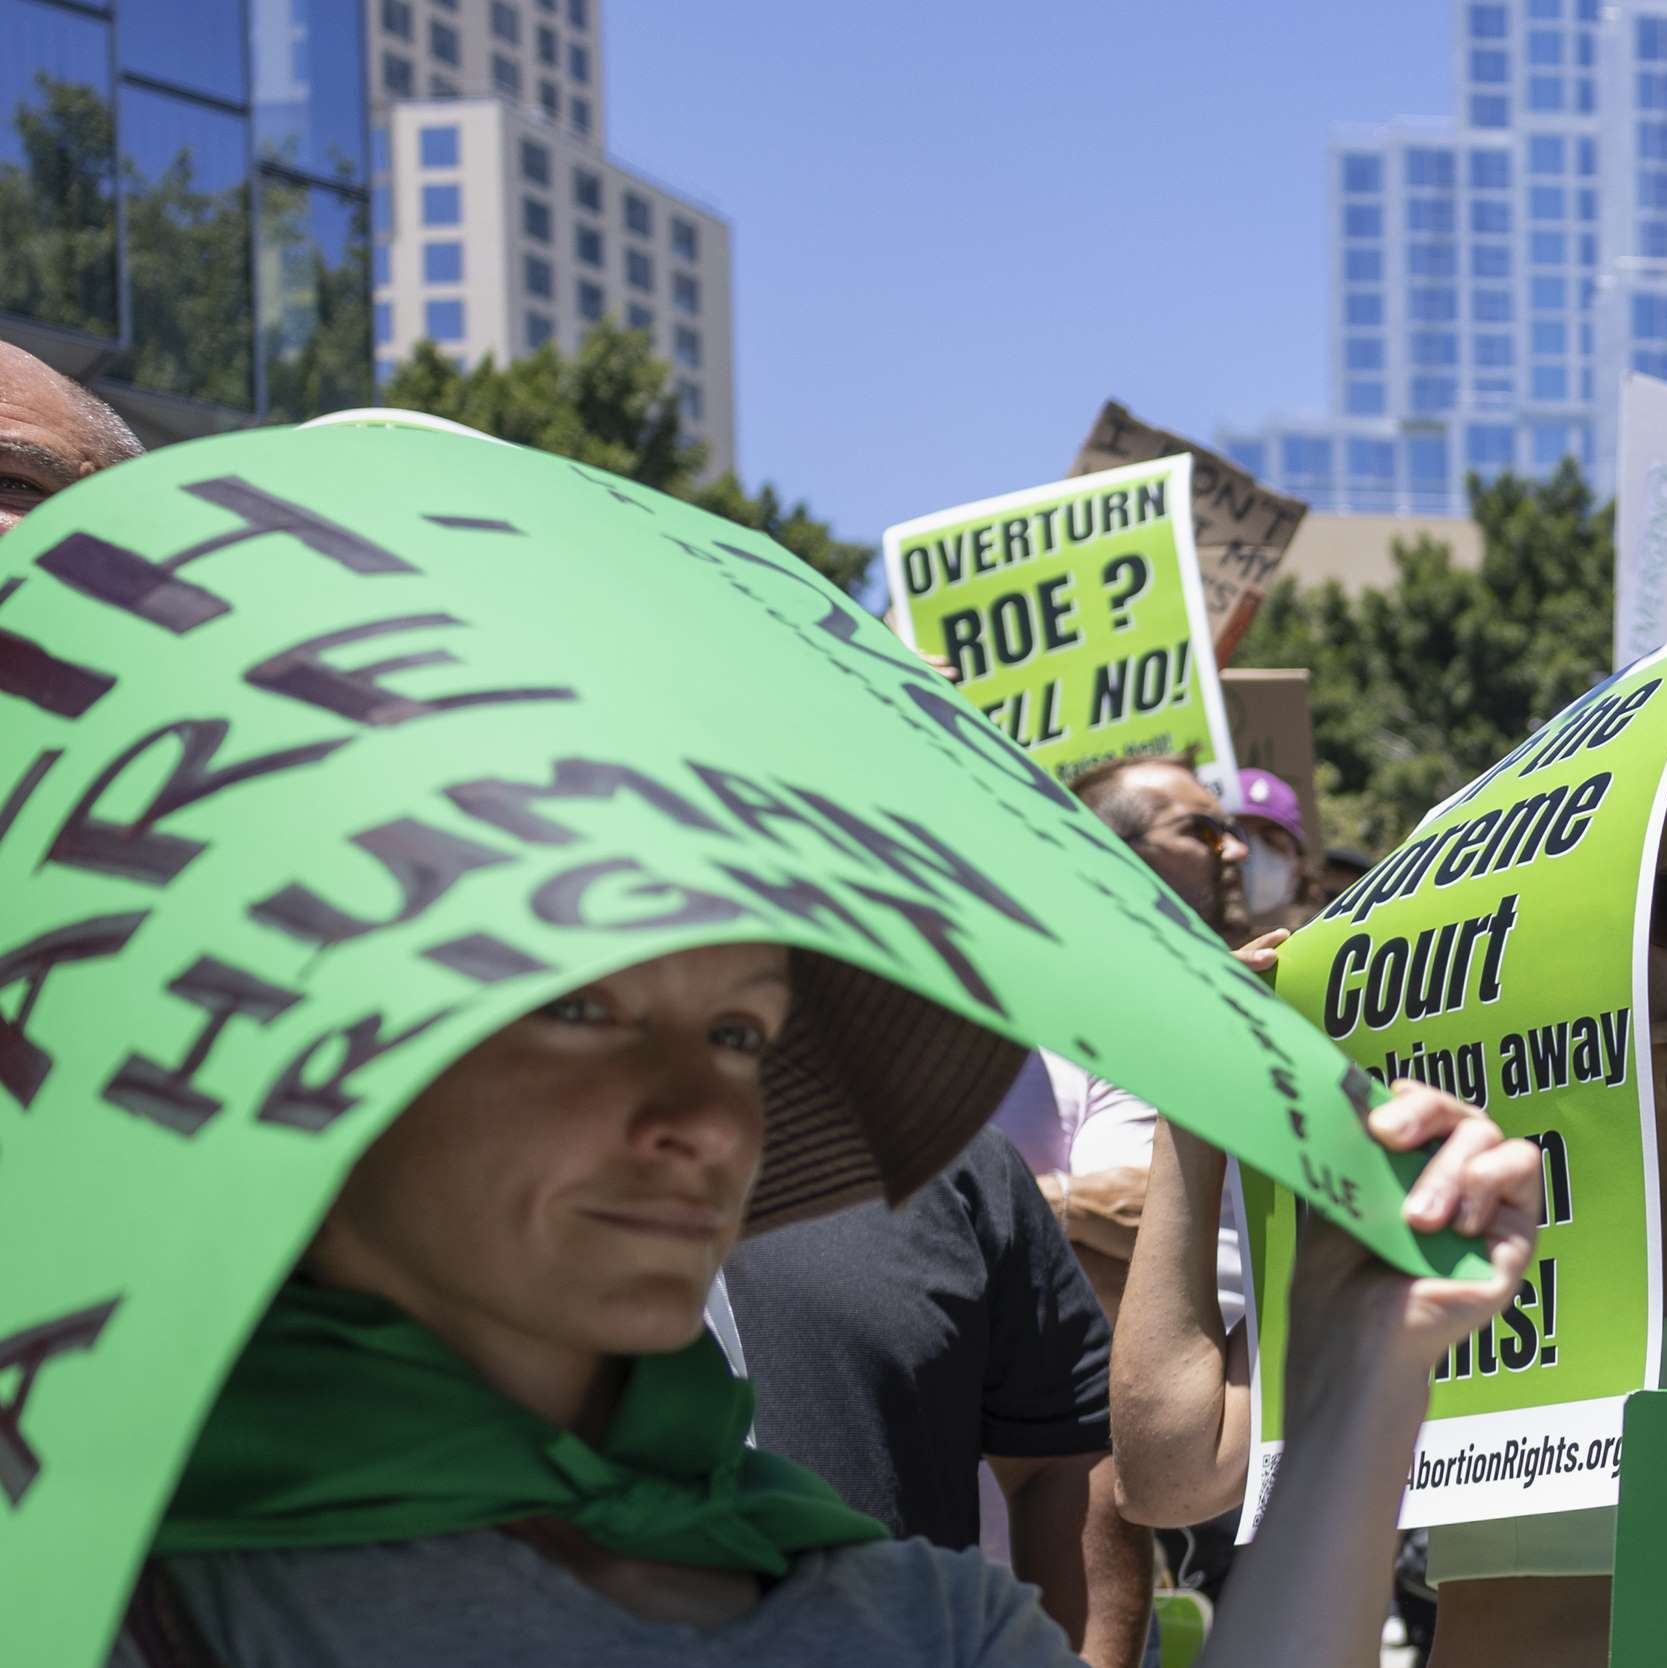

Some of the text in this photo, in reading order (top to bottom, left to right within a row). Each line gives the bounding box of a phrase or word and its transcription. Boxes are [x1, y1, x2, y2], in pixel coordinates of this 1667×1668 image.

[902, 479, 1168, 597] OVERTURN
[941, 574, 1078, 683] ROE
[1101, 553, 1151, 629] ?
[975, 681, 1064, 749] ELL
[1091, 640, 1192, 729] NO!
[1306, 771, 1613, 924] upreme
[98, 755, 1062, 1140] HUMAN
[1325, 893, 1518, 1042] Court
[1500, 1007, 1630, 1098] away
